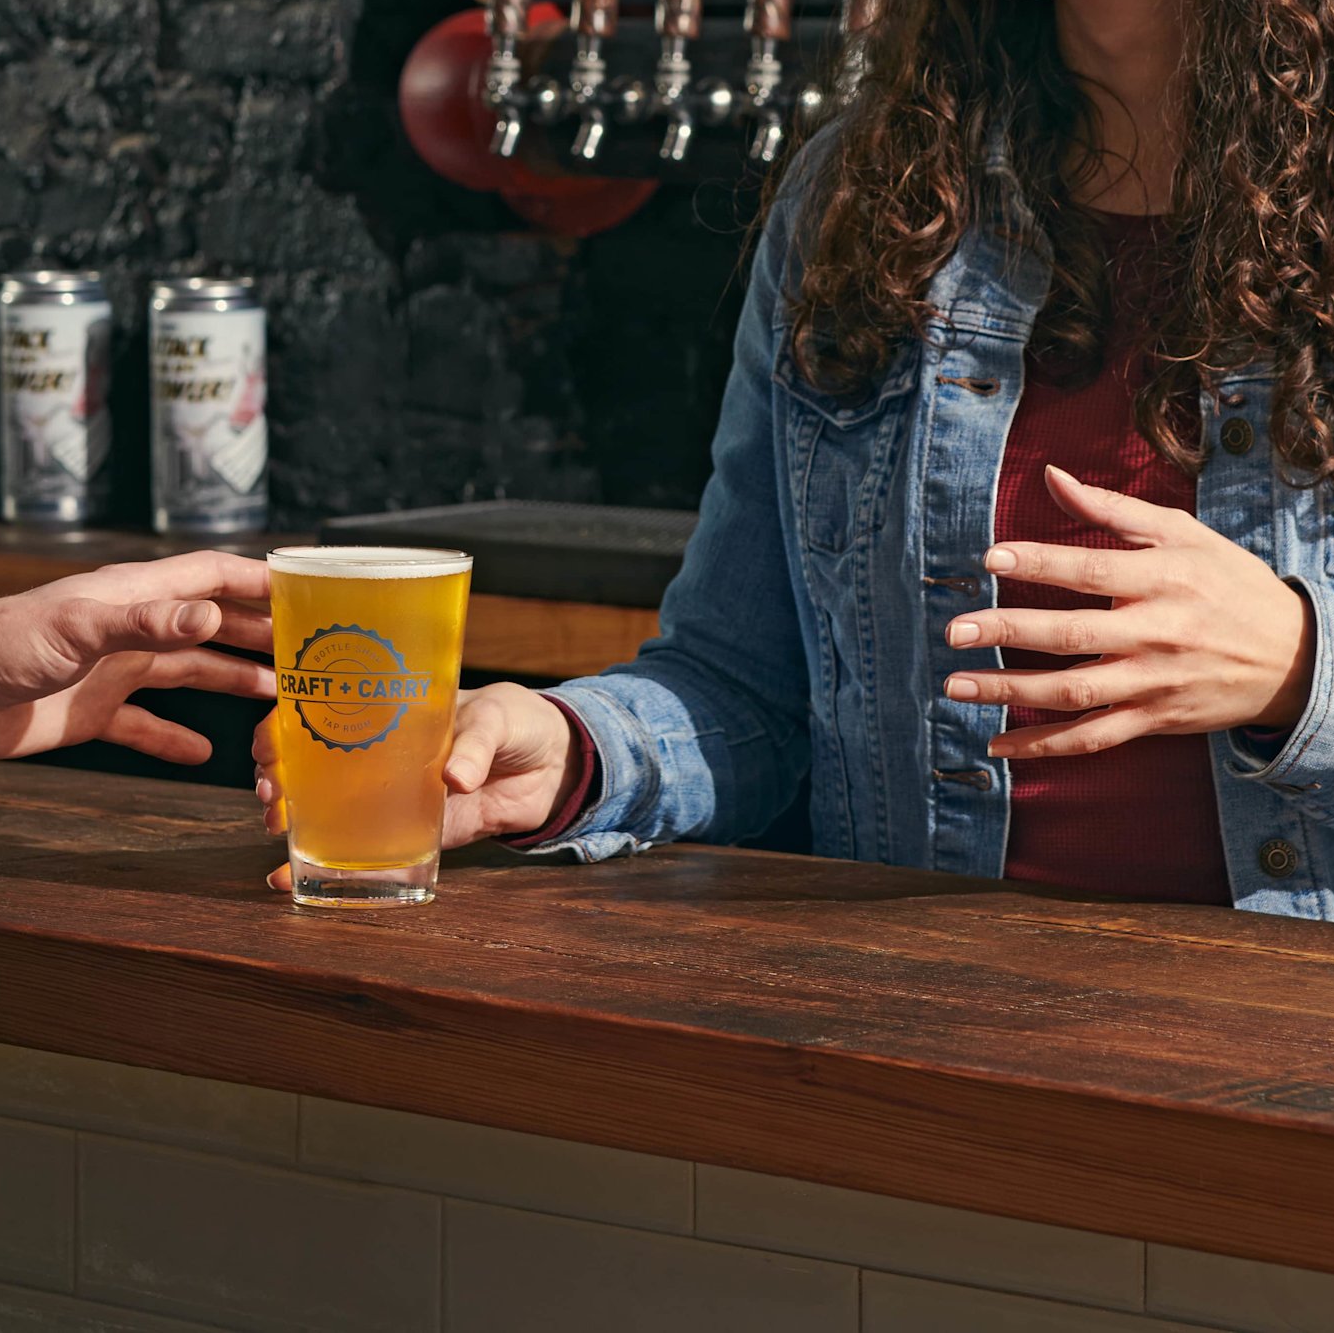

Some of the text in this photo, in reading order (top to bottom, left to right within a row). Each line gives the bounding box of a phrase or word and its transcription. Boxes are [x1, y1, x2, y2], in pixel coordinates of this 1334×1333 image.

[313, 643, 351, 664] BOTTLE
[281, 673, 333, 697] CRAFT
[357, 678, 432, 698] CARRY
[322, 717, 372, 733] TAP ROOM
